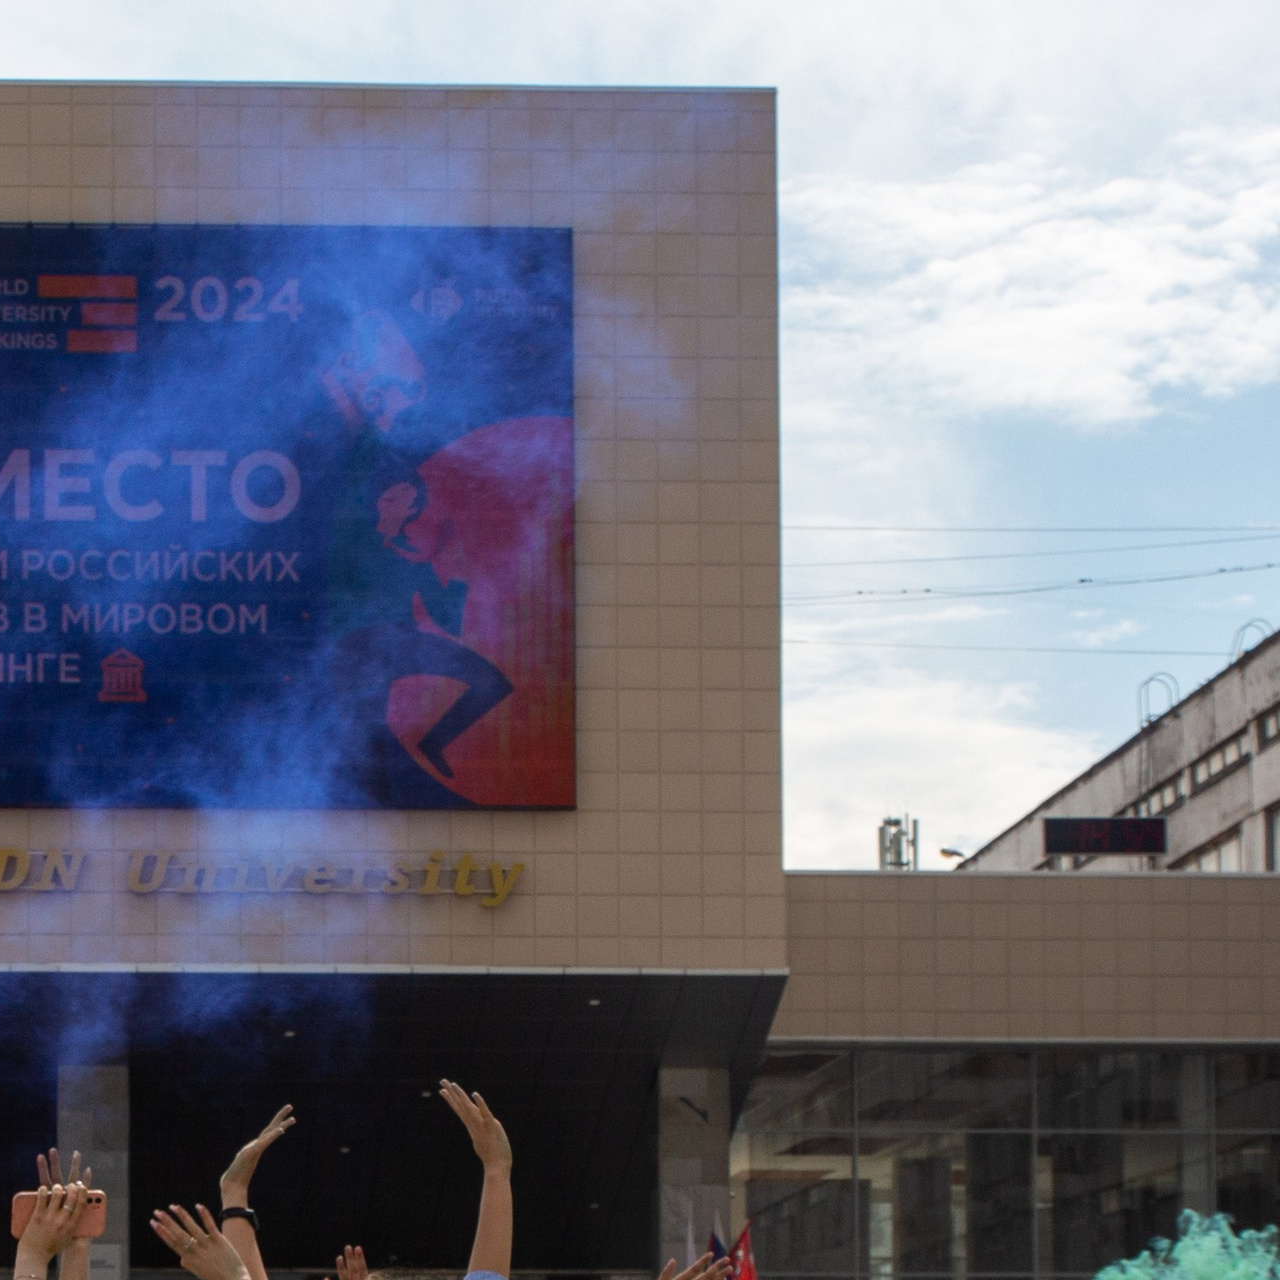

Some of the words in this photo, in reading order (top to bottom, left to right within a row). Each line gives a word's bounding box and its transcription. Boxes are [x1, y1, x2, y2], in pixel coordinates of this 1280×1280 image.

[155, 276, 304, 323] 2024
[22, 544, 301, 583] РОССИЙСКИХ
[25, 603, 47, 633] В
[62, 604, 267, 634] МИРОВОМ
[127, 850, 524, 907] University
